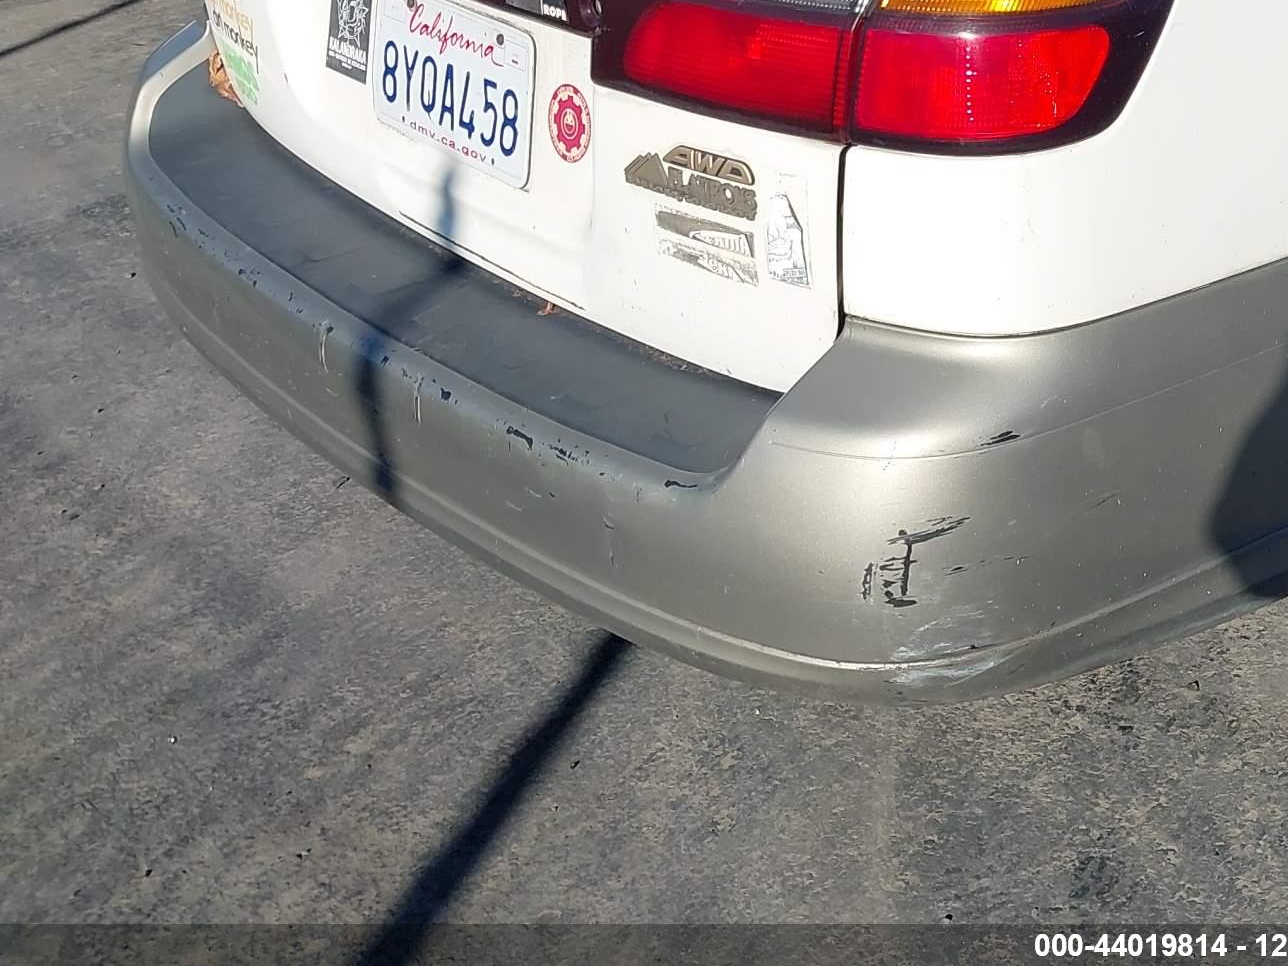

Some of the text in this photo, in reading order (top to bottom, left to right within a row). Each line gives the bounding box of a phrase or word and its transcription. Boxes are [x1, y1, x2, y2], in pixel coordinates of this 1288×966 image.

[408, 3, 505, 67] California
[382, 40, 519, 157] 8YQA458
[409, 118, 487, 163] dmv.ca.gov
[663, 145, 755, 186] AWD
